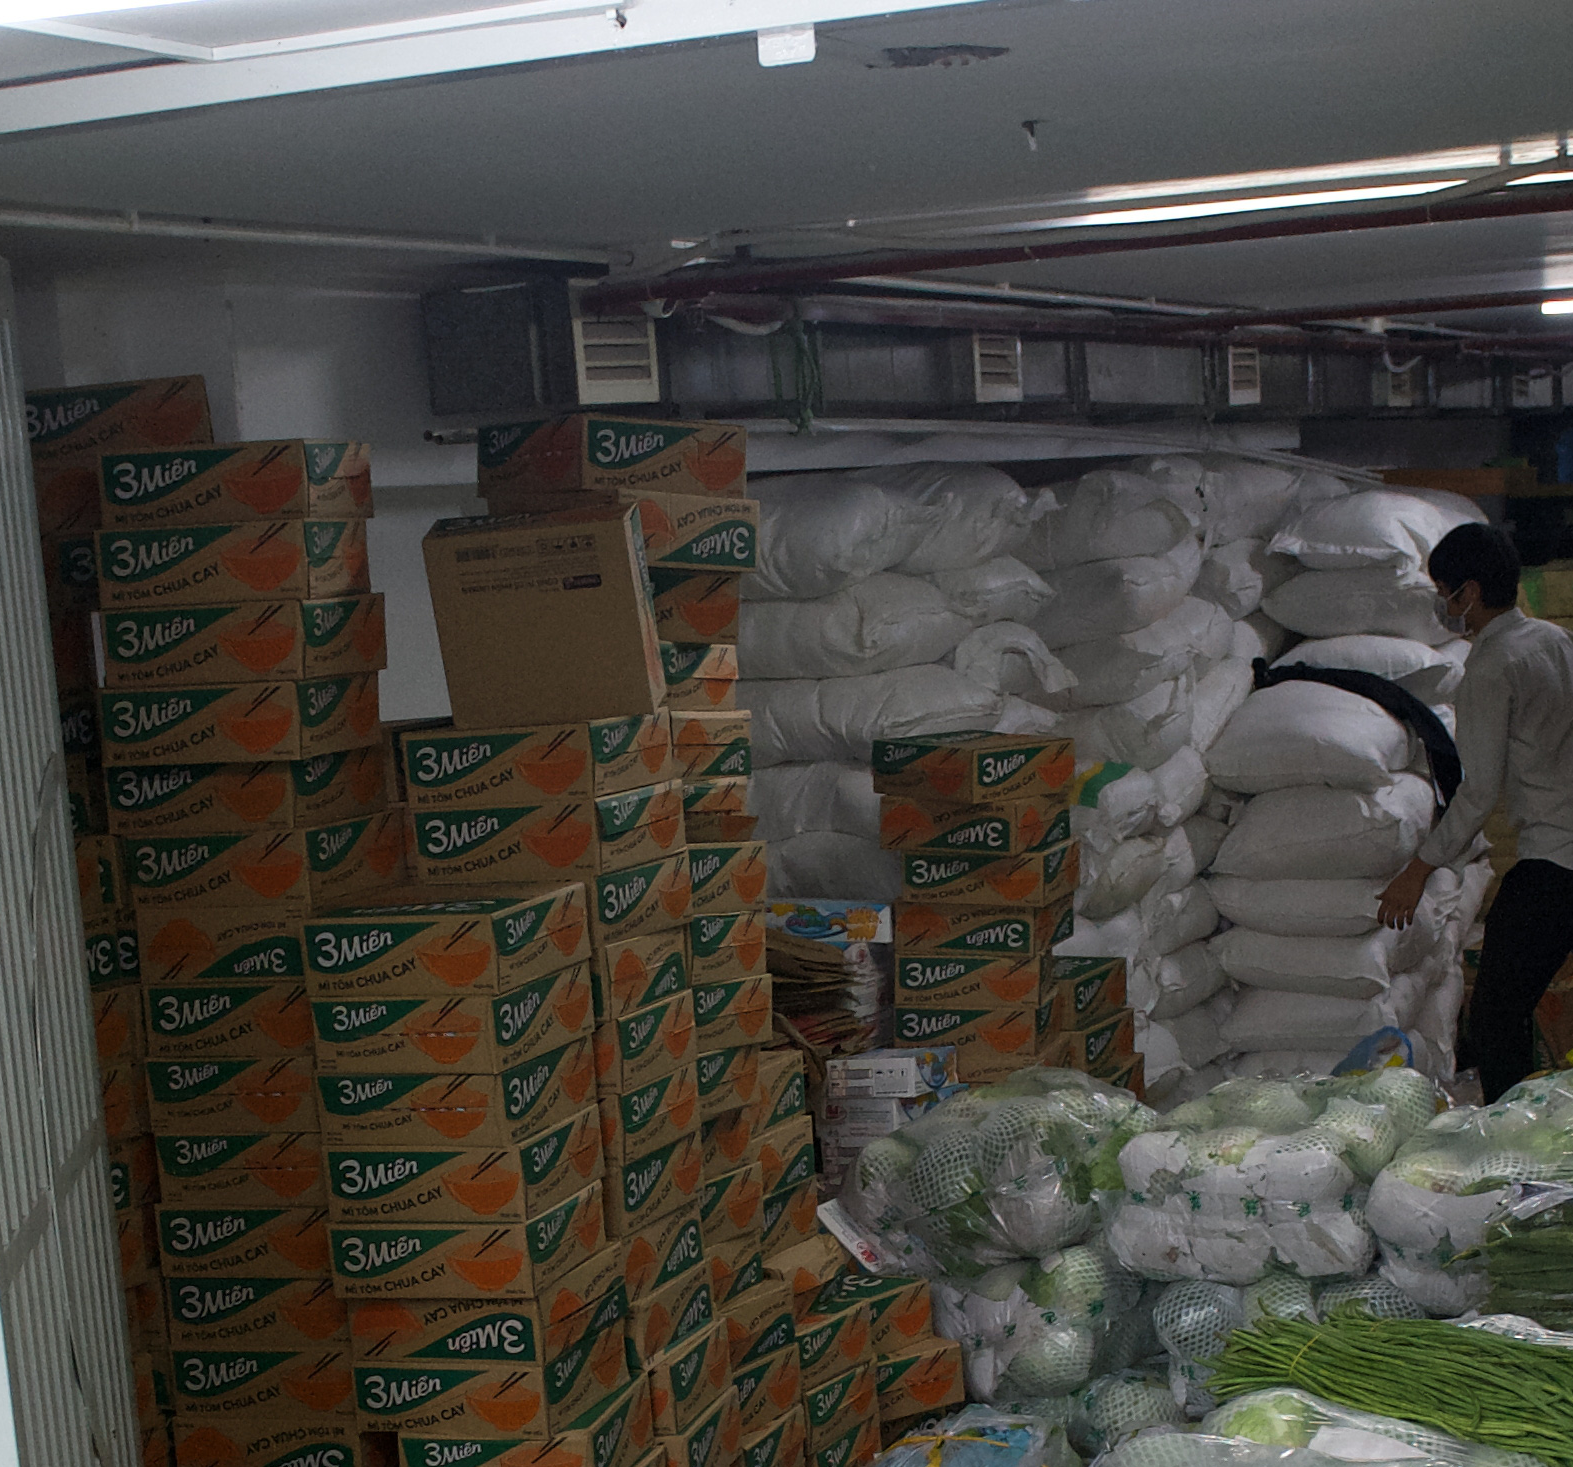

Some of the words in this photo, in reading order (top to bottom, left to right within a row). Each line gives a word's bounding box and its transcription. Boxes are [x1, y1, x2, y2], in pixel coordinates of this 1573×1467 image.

[628, 470, 659, 486] CHUA
[661, 461, 682, 477] CAY
[157, 499, 193, 518] CHUA
[195, 484, 223, 506] CAY
[154, 576, 190, 596] CHUA
[192, 562, 221, 583] CAY
[156, 659, 191, 676] CHUA
[193, 644, 218, 665] CAY
[153, 740, 188, 757] CHUA
[191, 725, 216, 745] CAY
[454, 782, 488, 800] CHUA
[490, 768, 515, 787] CAY
[463, 855, 496, 873] CHUA
[498, 841, 522, 861] CAY
[176, 883, 207, 902] CHUA
[209, 871, 232, 890] CAY
[356, 970, 390, 988] CHUA
[391, 958, 416, 978] CAY
[196, 1033, 226, 1049] CHUA
[229, 1020, 254, 1040] CAY
[381, 1196, 415, 1215] CHUA
[417, 1187, 442, 1205] CAY
[210, 1255, 244, 1270] CHUA
[245, 1243, 269, 1260] CAY
[384, 1275, 419, 1292] CHUA
[421, 1264, 446, 1283] CAY
[423, 1308, 448, 1325] CAY
[449, 1301, 483, 1316] CHUA
[218, 1322, 251, 1339] CHUA
[252, 1311, 277, 1330] CAY
[222, 1396, 256, 1411] CHUA
[257, 1385, 281, 1402] CAY
[405, 1412, 439, 1429] CHUA
[441, 1403, 465, 1420] CAY
[246, 1436, 270, 1456] CAY
[272, 1429, 306, 1444] CHUA
